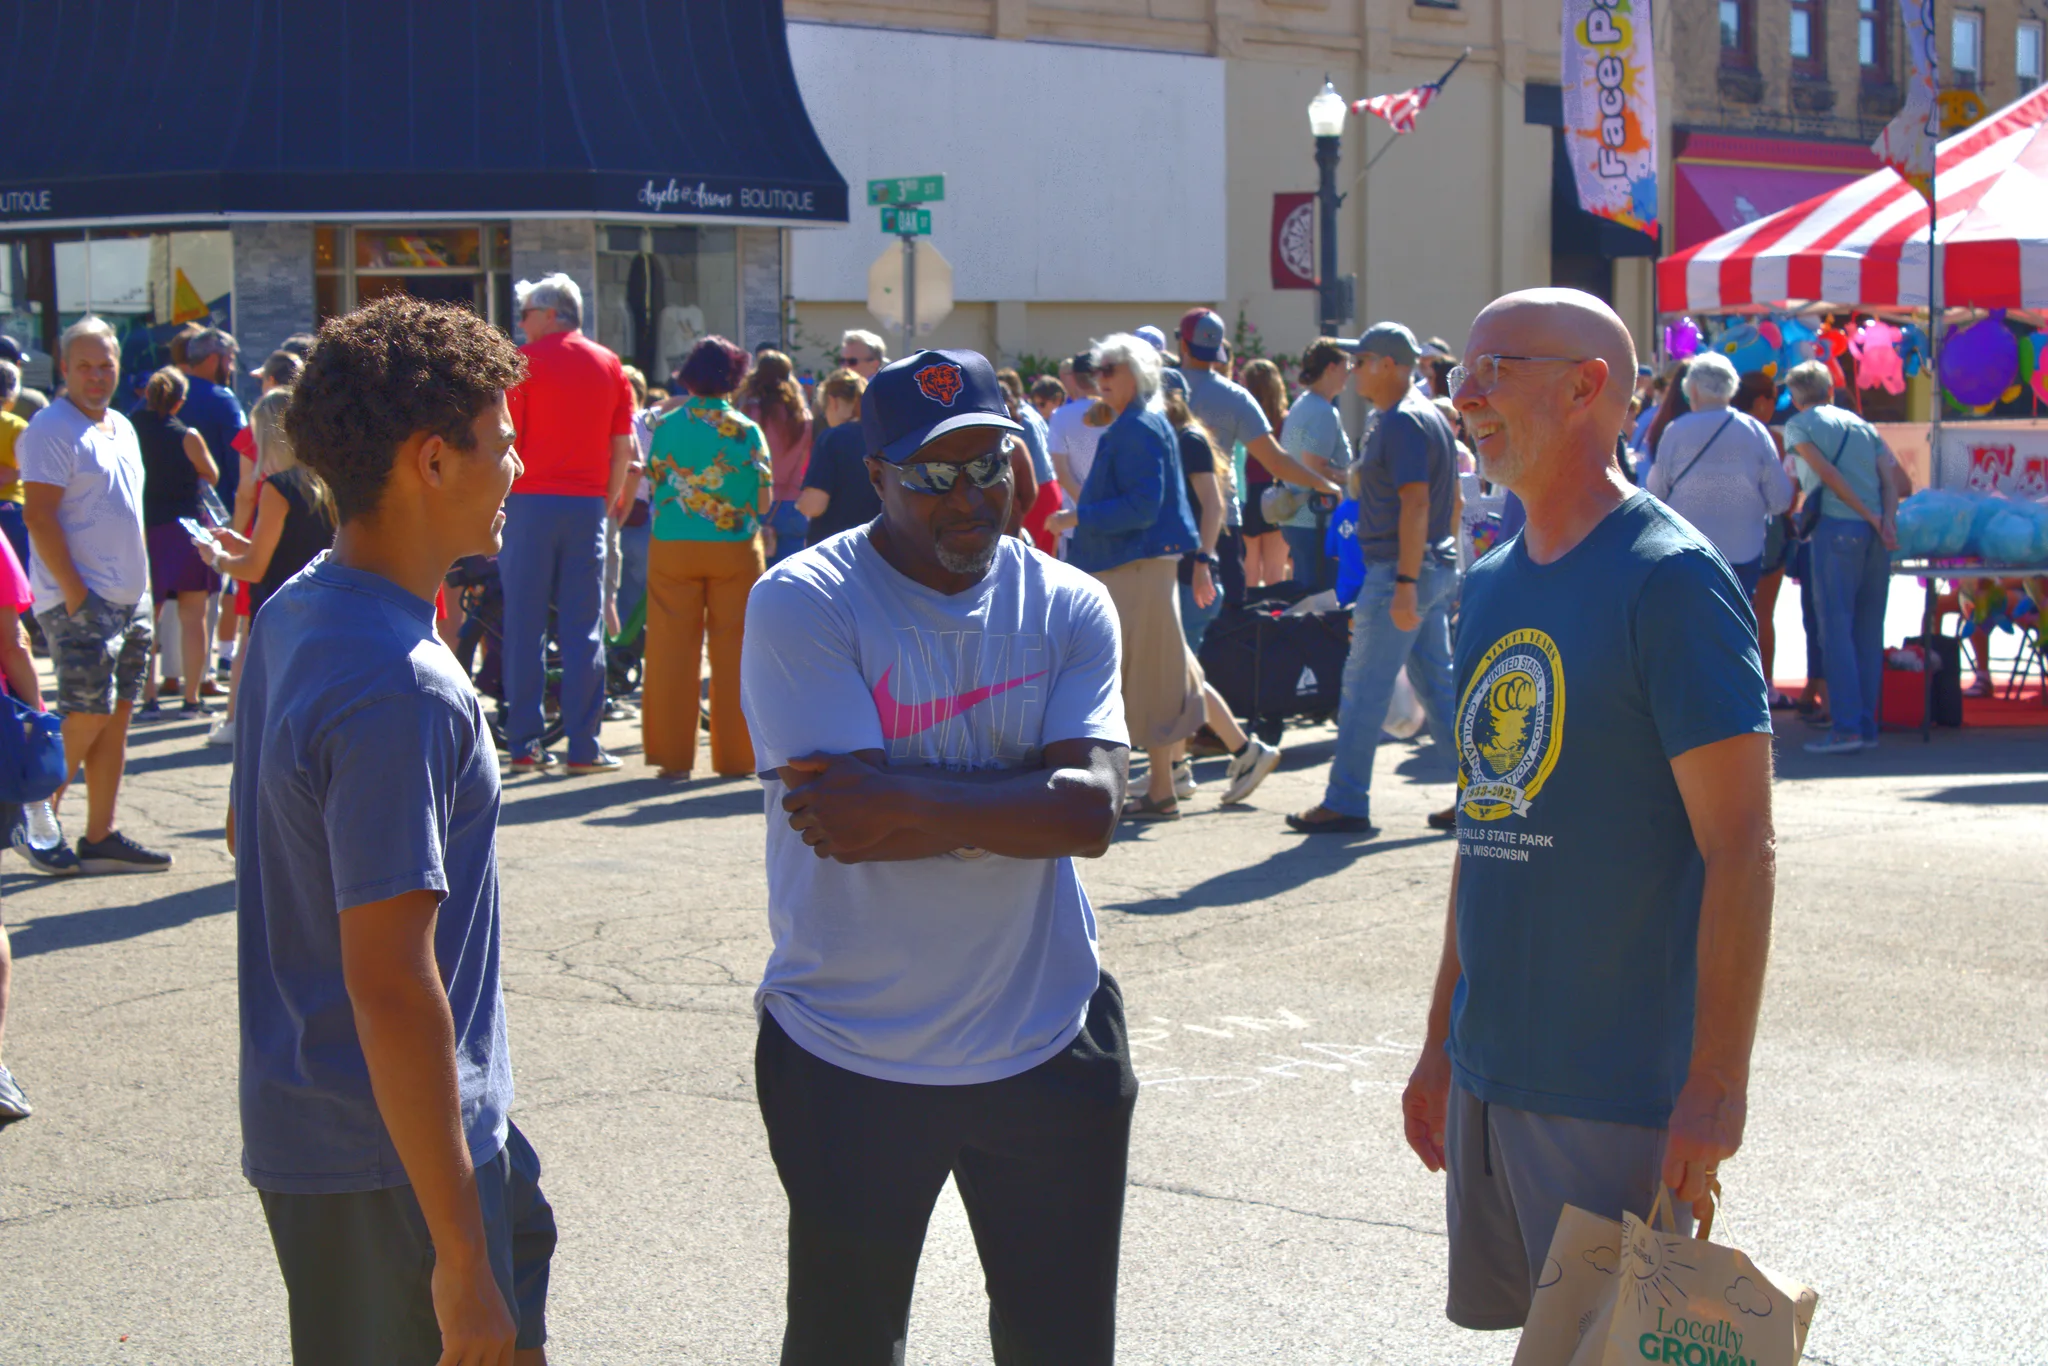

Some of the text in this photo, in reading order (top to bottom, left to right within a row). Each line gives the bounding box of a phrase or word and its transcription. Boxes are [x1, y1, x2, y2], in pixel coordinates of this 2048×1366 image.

[1597, 56, 1628, 178] Face
[740, 188, 816, 212] BOUTIQUE
[924, 182, 935, 196] ST
[898, 209, 918, 234] OAK
[1485, 631, 1558, 662] NINETY YEARS
[1486, 656, 1543, 685] UNITED STATES
[889, 625, 1043, 763] NIKE
[1464, 702, 1480, 768] CIVILIAN
[1532, 700, 1545, 752] CORPS
[1464, 784, 1518, 803] 1933-2023
[1463, 828, 1486, 841] FALLS
[1487, 829, 1517, 844] STATE
[1520, 833, 1554, 848] PARK
[1473, 844, 1529, 862] WISCONSIN
[1656, 1306, 1744, 1358] Locally
